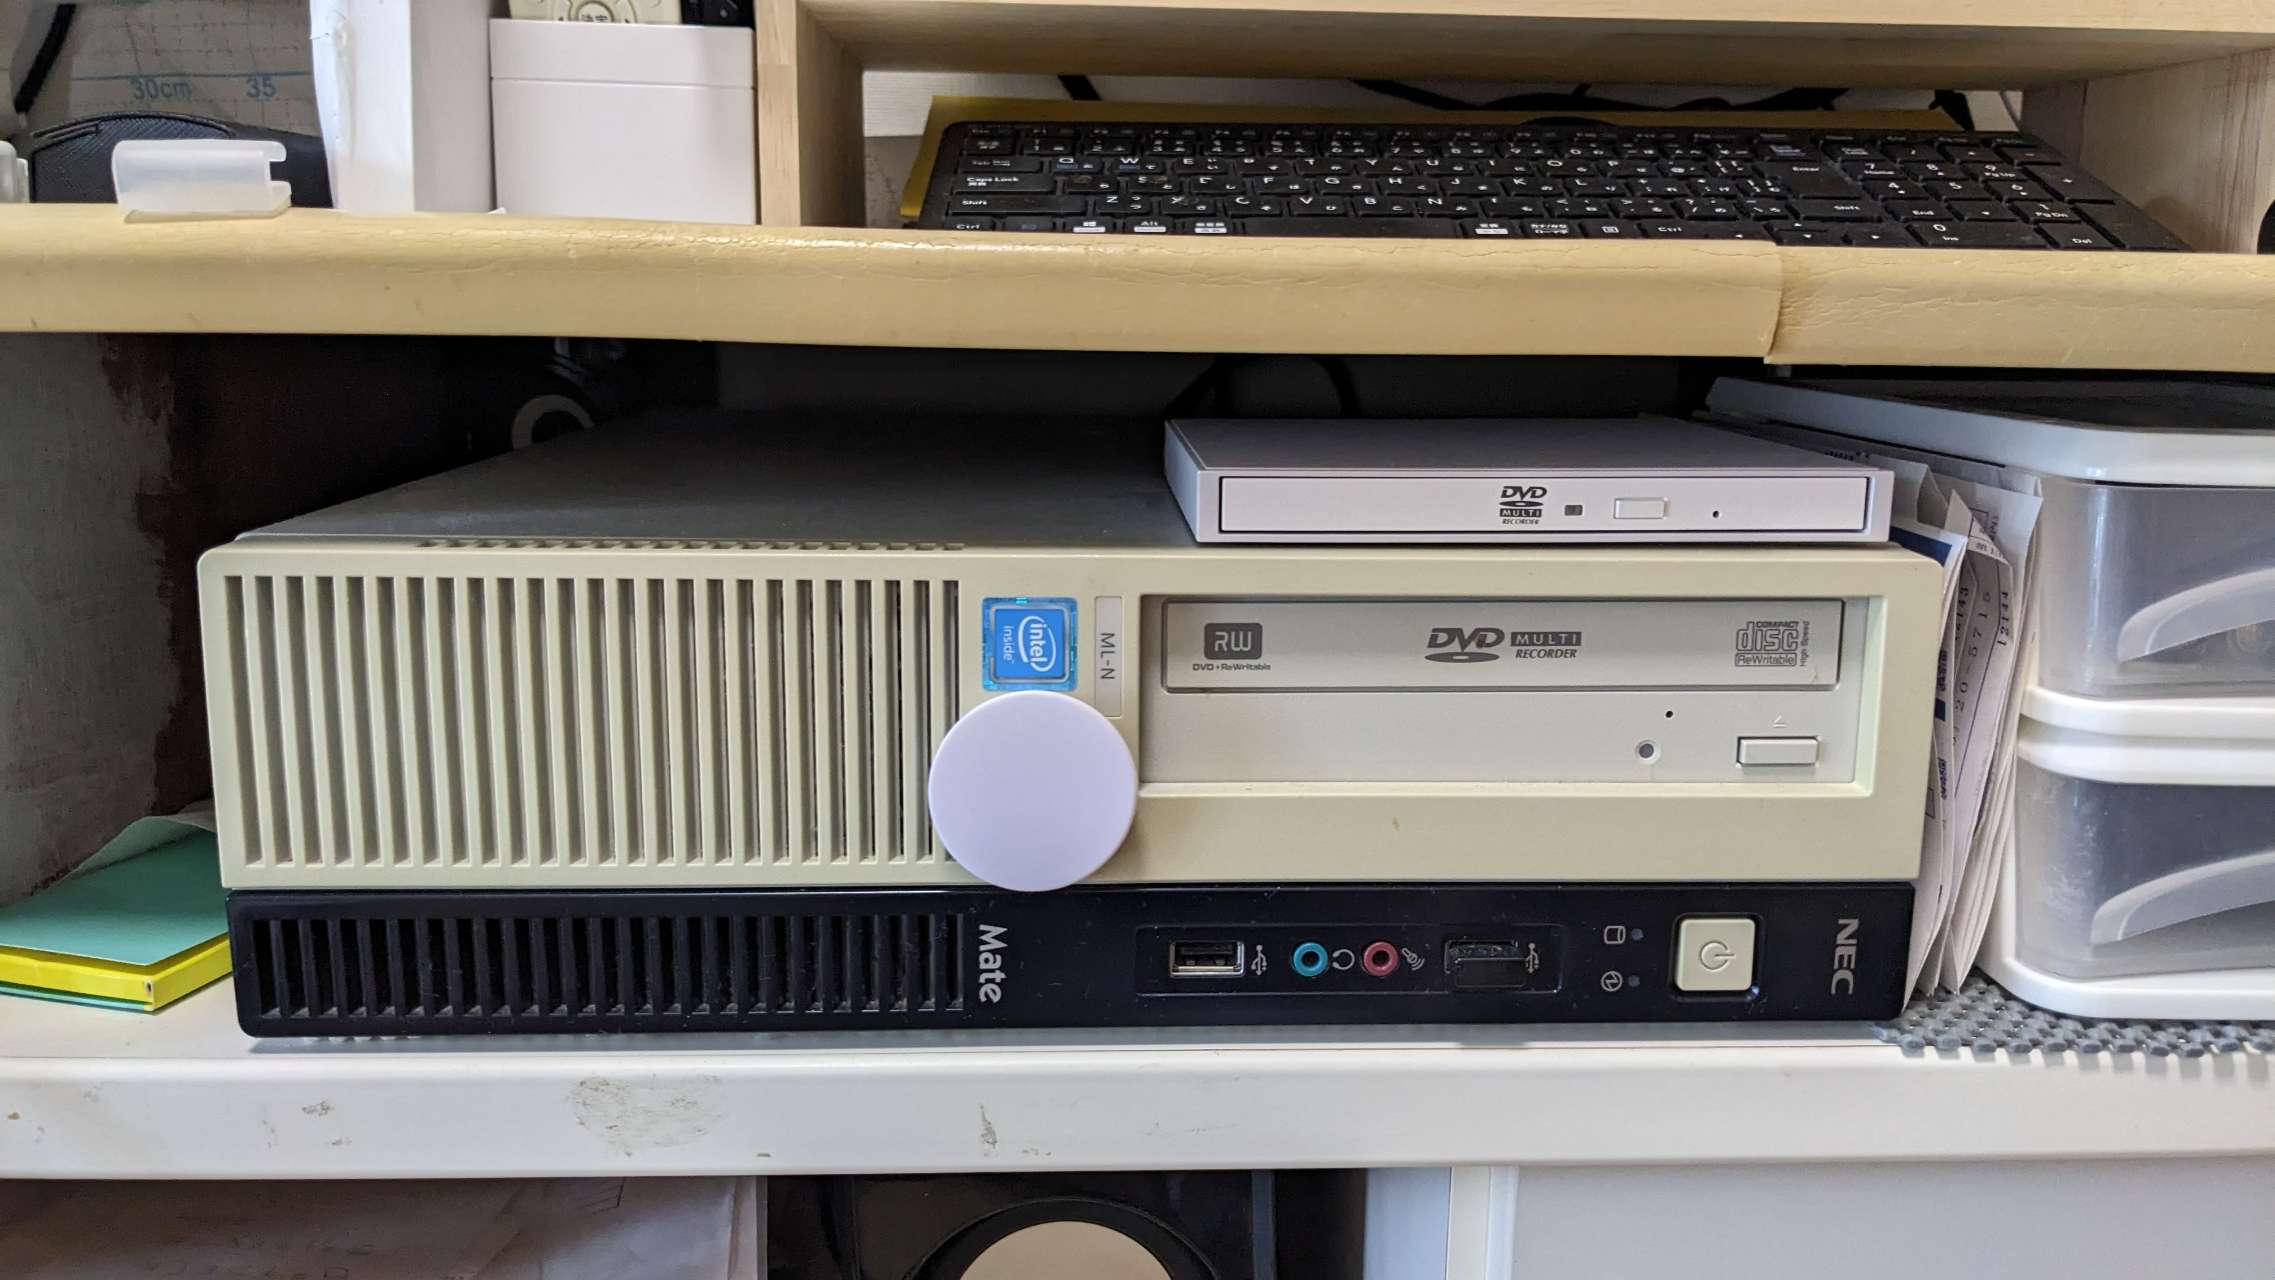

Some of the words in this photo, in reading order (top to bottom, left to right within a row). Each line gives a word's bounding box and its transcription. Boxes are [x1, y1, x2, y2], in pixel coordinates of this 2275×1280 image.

[130, 78, 192, 100] 30cm
[246, 78, 276, 98] 35
[1501, 486, 1547, 500] DVD
[1502, 509, 1540, 517] MULTI
[1997, 591, 2009, 647] 12144
[1003, 625, 1015, 661] inside
[1029, 623, 1048, 662] intel
[1214, 631, 1252, 652] RW
[1427, 627, 1505, 652] DVD
[1515, 633, 1577, 645] MULTI
[1736, 621, 1799, 651] disc
[1100, 632, 1116, 680] ML-N
[1515, 649, 1578, 659] RECORDER
[1738, 654, 1794, 664] ReWritable
[979, 924, 1008, 1003] Mate
[1831, 919, 1859, 995] NEC
